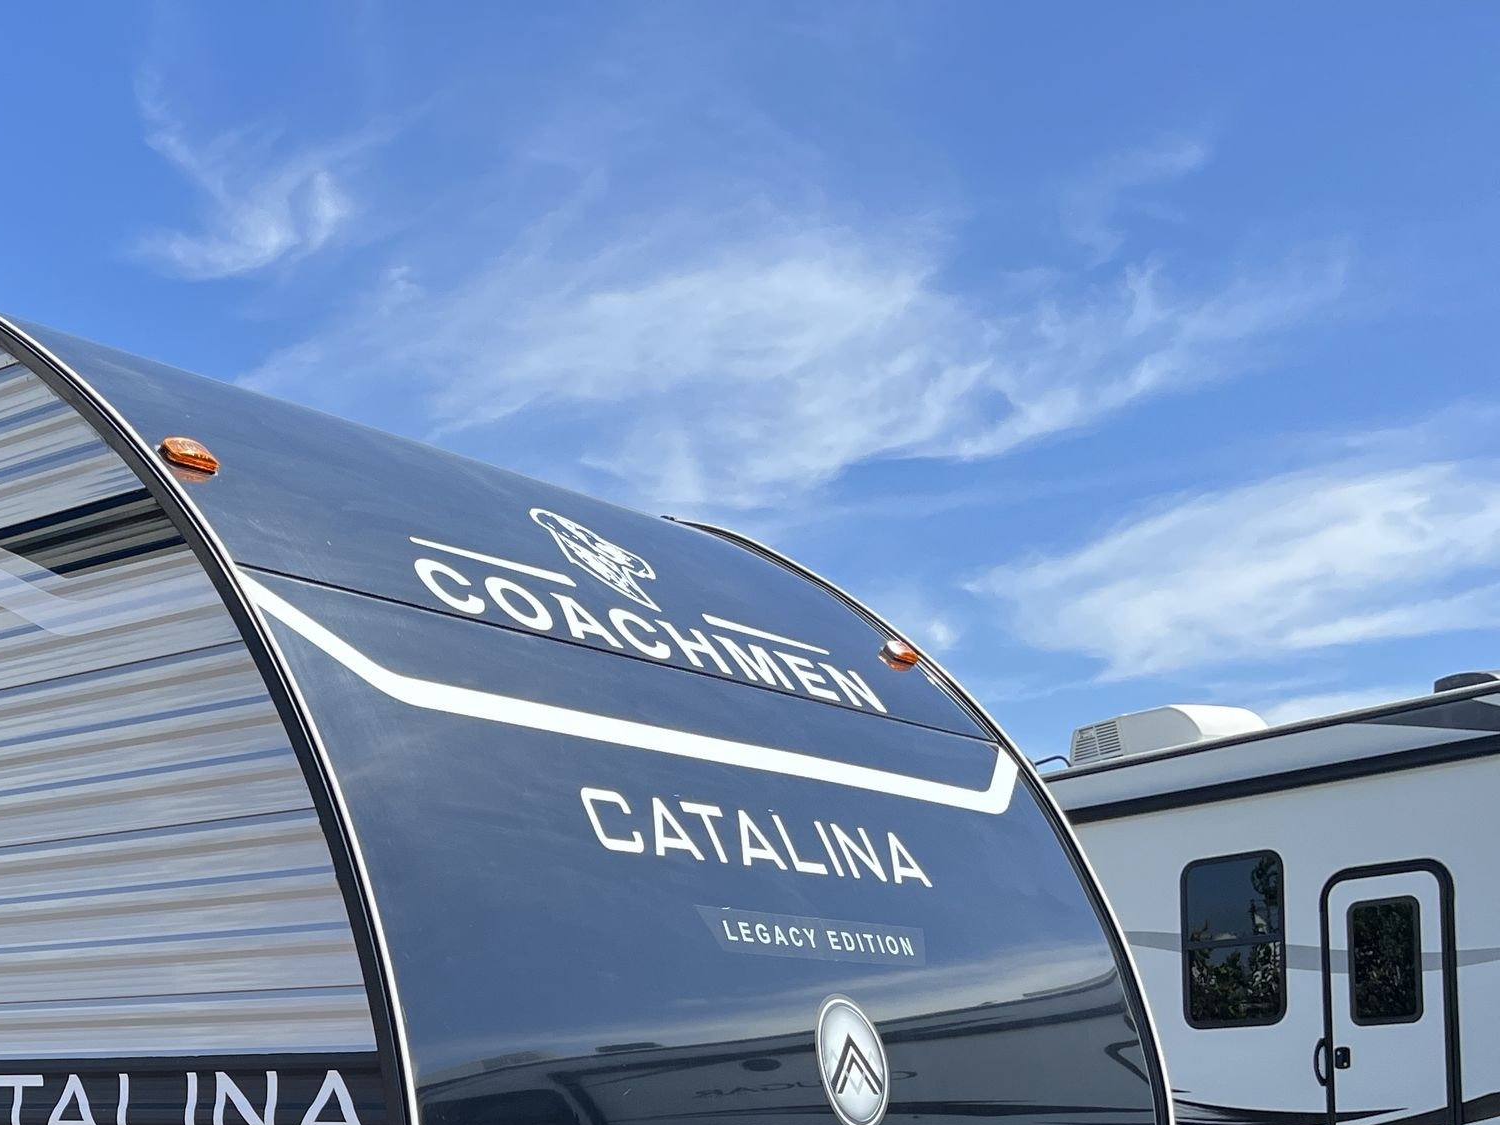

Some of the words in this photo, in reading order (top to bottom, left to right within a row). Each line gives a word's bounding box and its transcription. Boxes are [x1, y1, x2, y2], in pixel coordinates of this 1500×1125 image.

[413, 557, 888, 714] COACHMEN
[580, 786, 934, 888] CATALINA
[722, 919, 817, 949] LEGACY
[826, 930, 915, 957] EDITION
